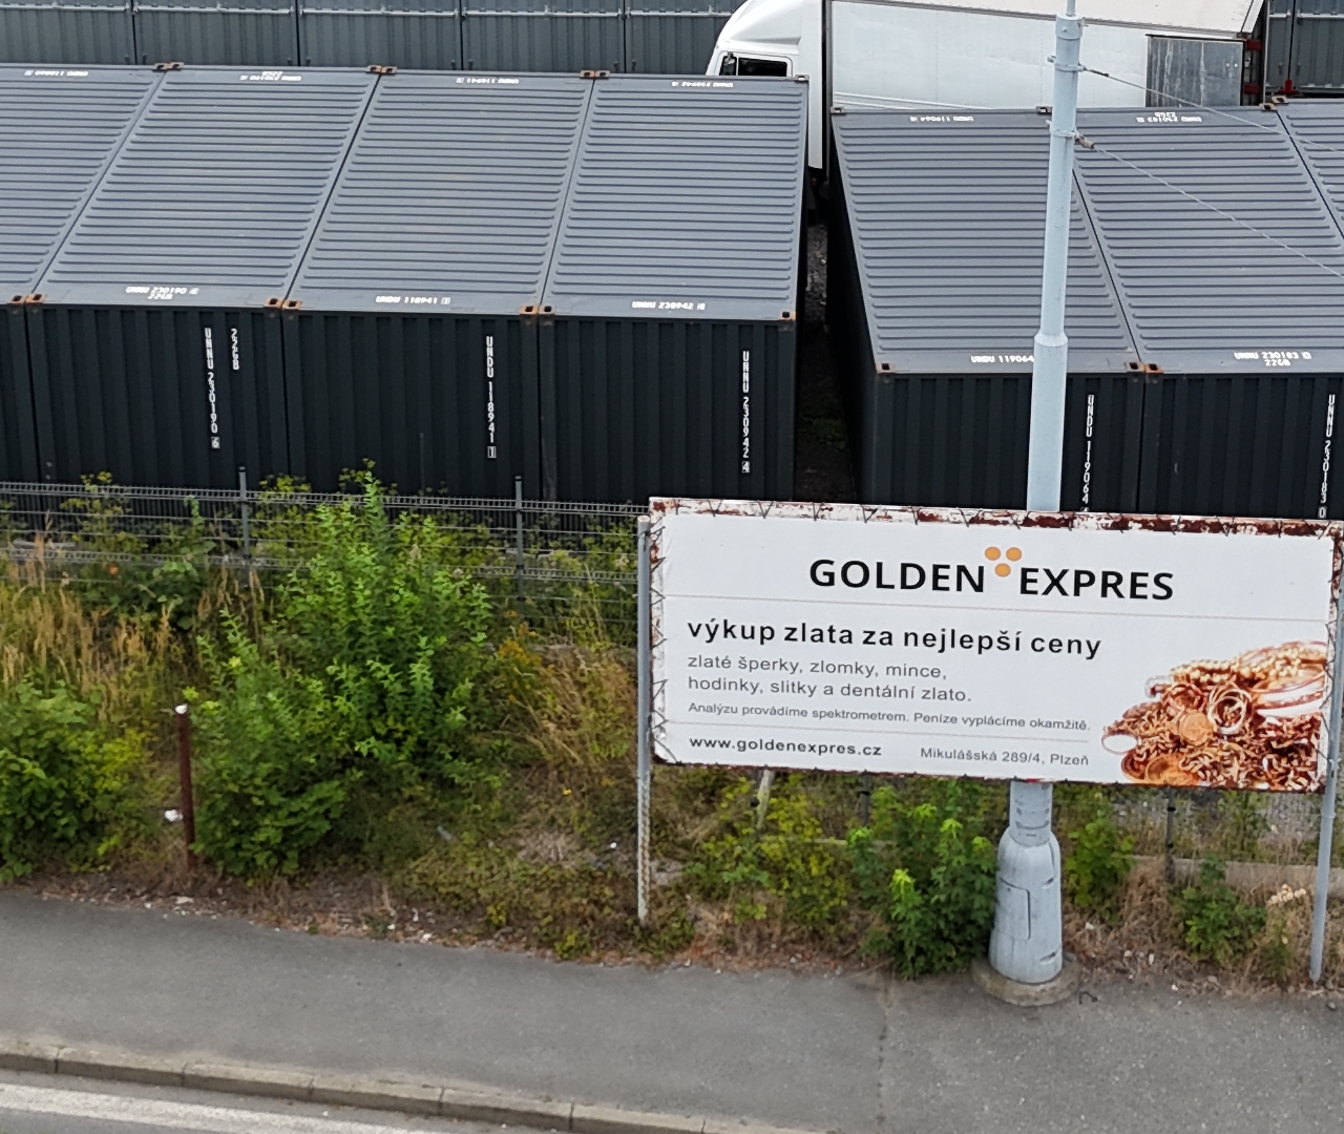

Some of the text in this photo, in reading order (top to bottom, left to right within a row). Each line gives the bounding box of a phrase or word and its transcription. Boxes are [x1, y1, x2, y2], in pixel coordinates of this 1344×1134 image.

[485, 335, 494, 378] UNDU
[742, 396, 750, 459] 230942
[1081, 394, 1095, 505] UNDU 119064
[1318, 394, 1336, 518] UNNU 230183 0
[809, 559, 1174, 601] GOLDEN EXPRES
[687, 617, 1102, 661] výkup zlata za nejlepší ceny
[687, 654, 947, 681] zlaté šperky, zlomky, mince,
[688, 675, 972, 703] hodinky, slitky a dentální zlato.
[687, 702, 1091, 732] Analýzu provádíme spektrometrem. Peníze vyplácíme okamžitě.
[689, 737, 882, 758] www.goldenexpres.cz
[920, 747, 1090, 766] Mikulášská 289/4, Plzeň
